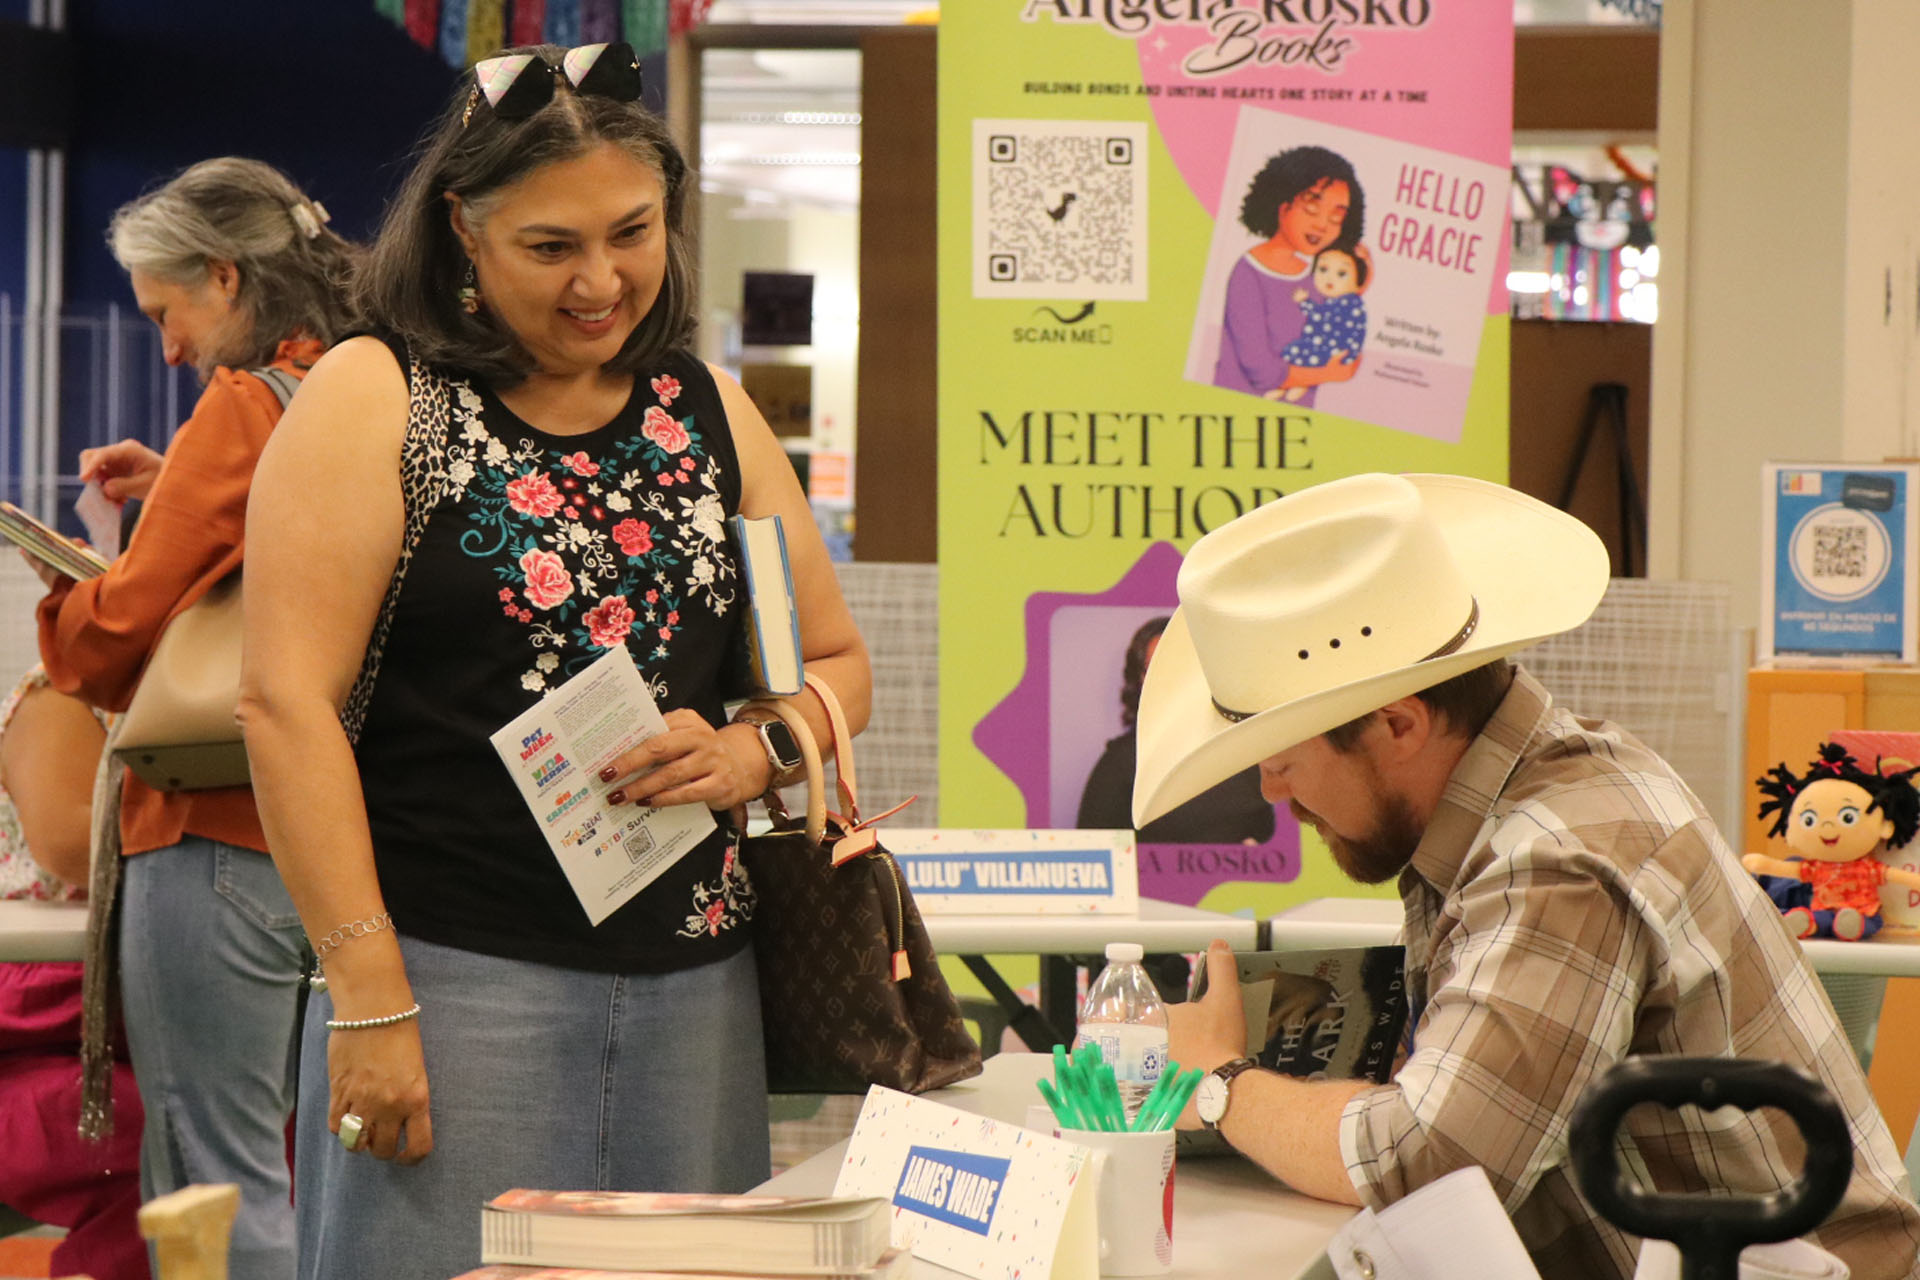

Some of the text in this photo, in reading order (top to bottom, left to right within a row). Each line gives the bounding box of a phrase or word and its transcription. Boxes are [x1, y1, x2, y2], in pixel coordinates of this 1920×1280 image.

[1186, 11, 1351, 73] Books
[1024, 82, 1428, 103] BUILDING BONDS AND UNITING HEARTS ONE STORY AT A TIME
[1396, 163, 1485, 221] HELLO
[1379, 212, 1482, 273] GRACIE
[1013, 327, 1096, 343] SCAN ME
[978, 410, 1313, 470] MEET THE
[531, 752, 565, 781] VIDA
[627, 804, 663, 831] Surve
[973, 861, 1109, 889] VILLANUEVA
[1177, 850, 1286, 875] ROSKO
[1276, 1017, 1306, 1067] THE
[1364, 1041, 1384, 1080] MES
[899, 1155, 999, 1224] JAMES WADE
